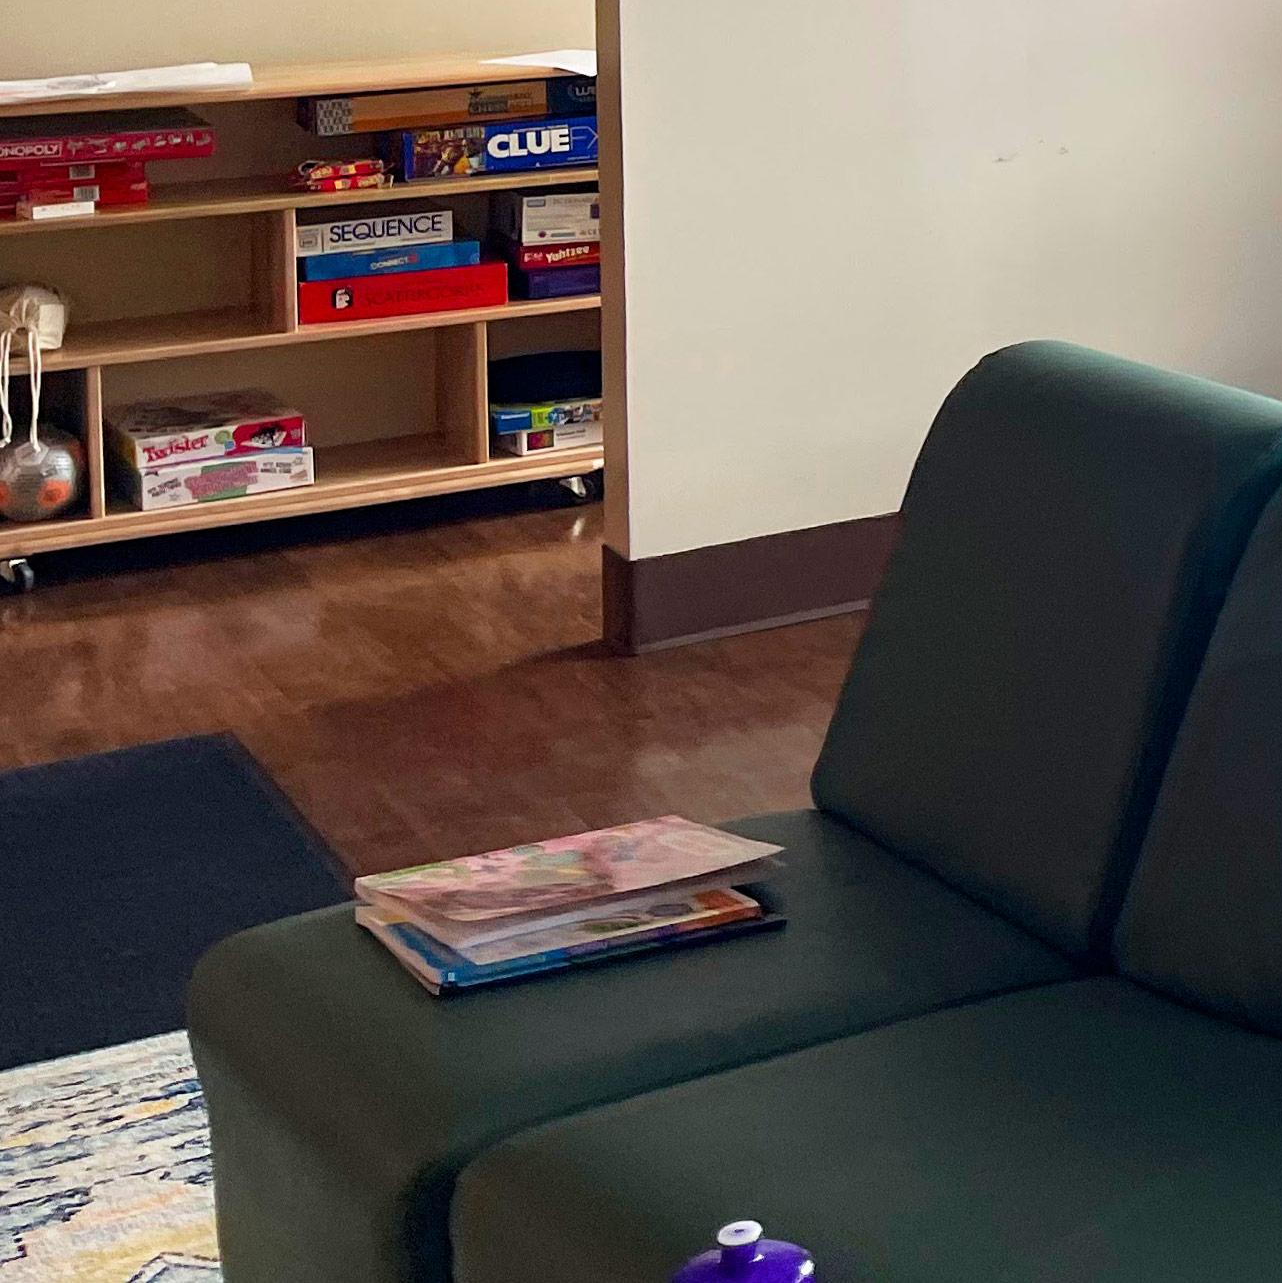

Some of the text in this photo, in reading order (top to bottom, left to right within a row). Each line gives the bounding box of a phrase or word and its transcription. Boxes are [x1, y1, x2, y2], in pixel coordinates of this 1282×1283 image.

[487, 126, 569, 158] CLUE
[329, 215, 443, 243] SEQUENCE
[143, 434, 209, 463] Twister
